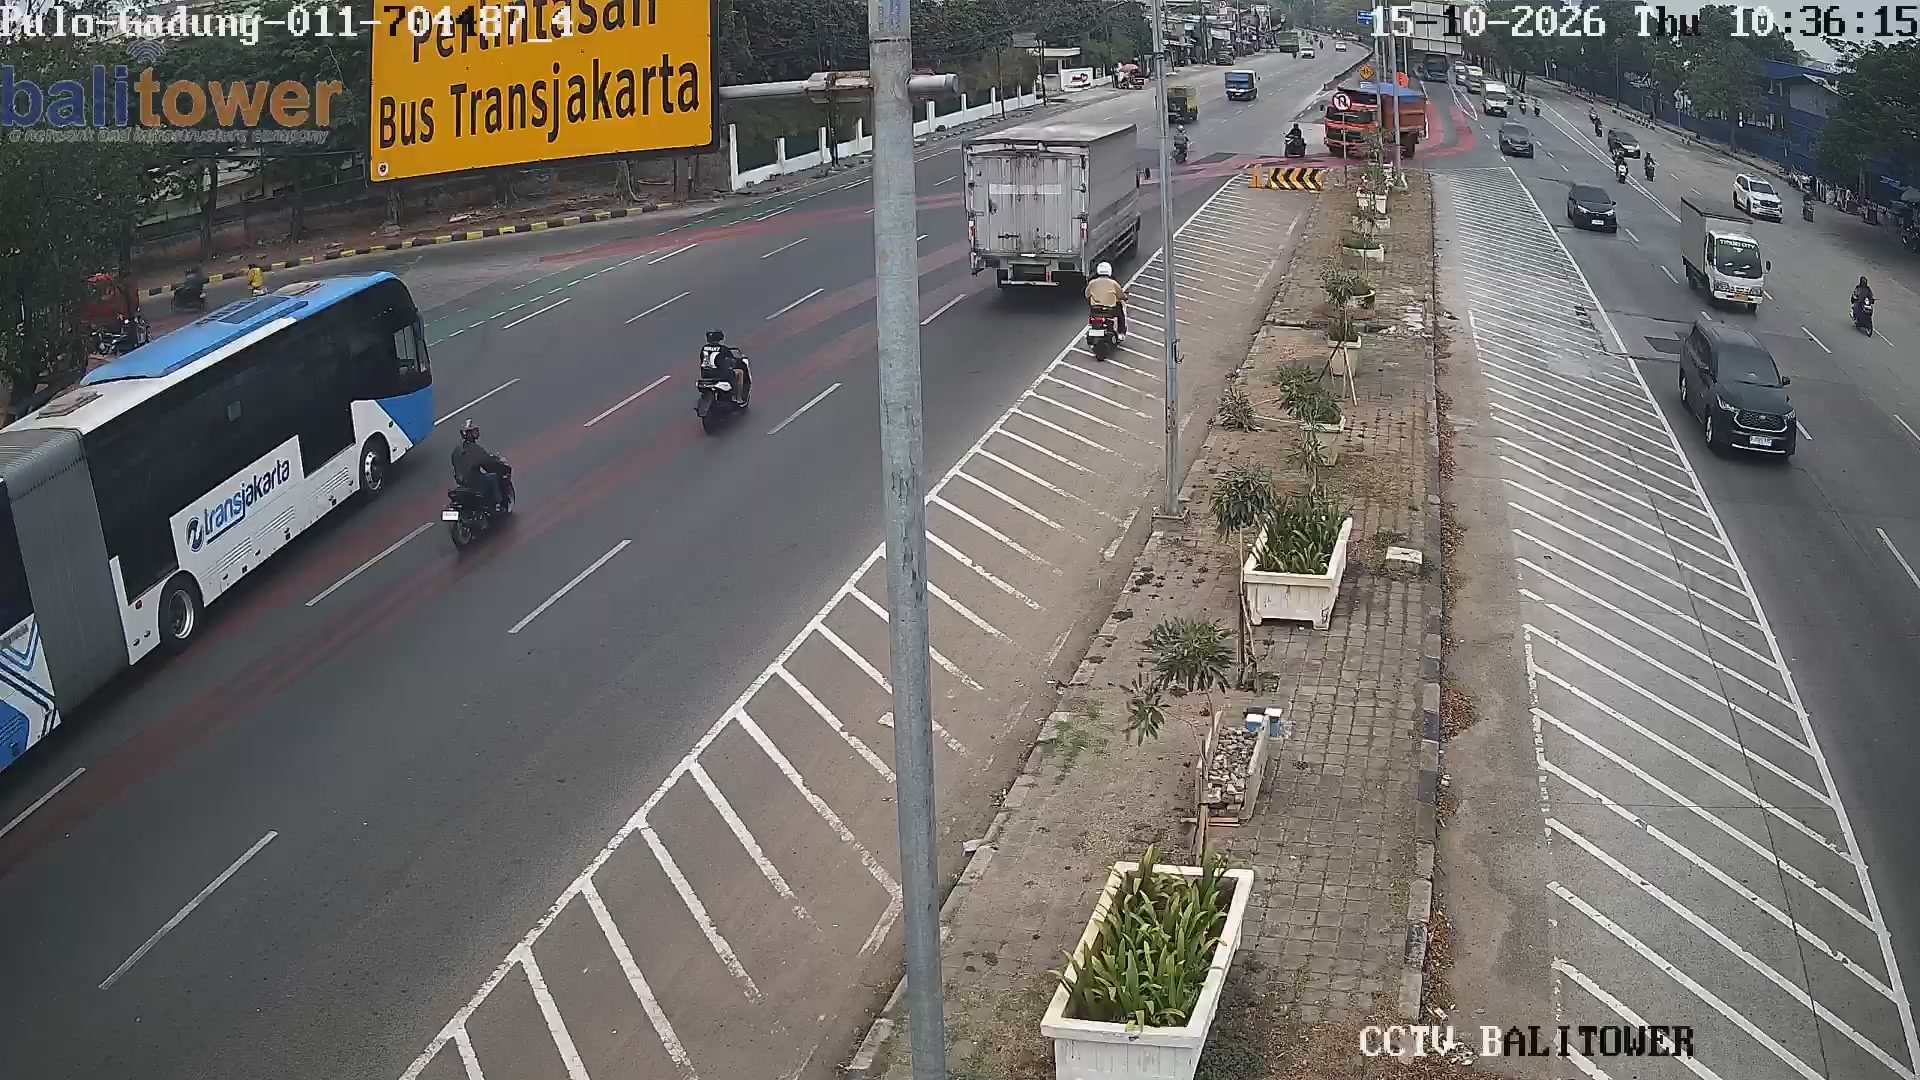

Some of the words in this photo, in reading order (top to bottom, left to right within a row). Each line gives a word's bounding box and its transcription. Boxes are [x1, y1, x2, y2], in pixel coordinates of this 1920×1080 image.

[379, 96, 435, 149] Bus
[450, 53, 700, 143] Transjakarta
[204, 459, 290, 544] transjakarta
